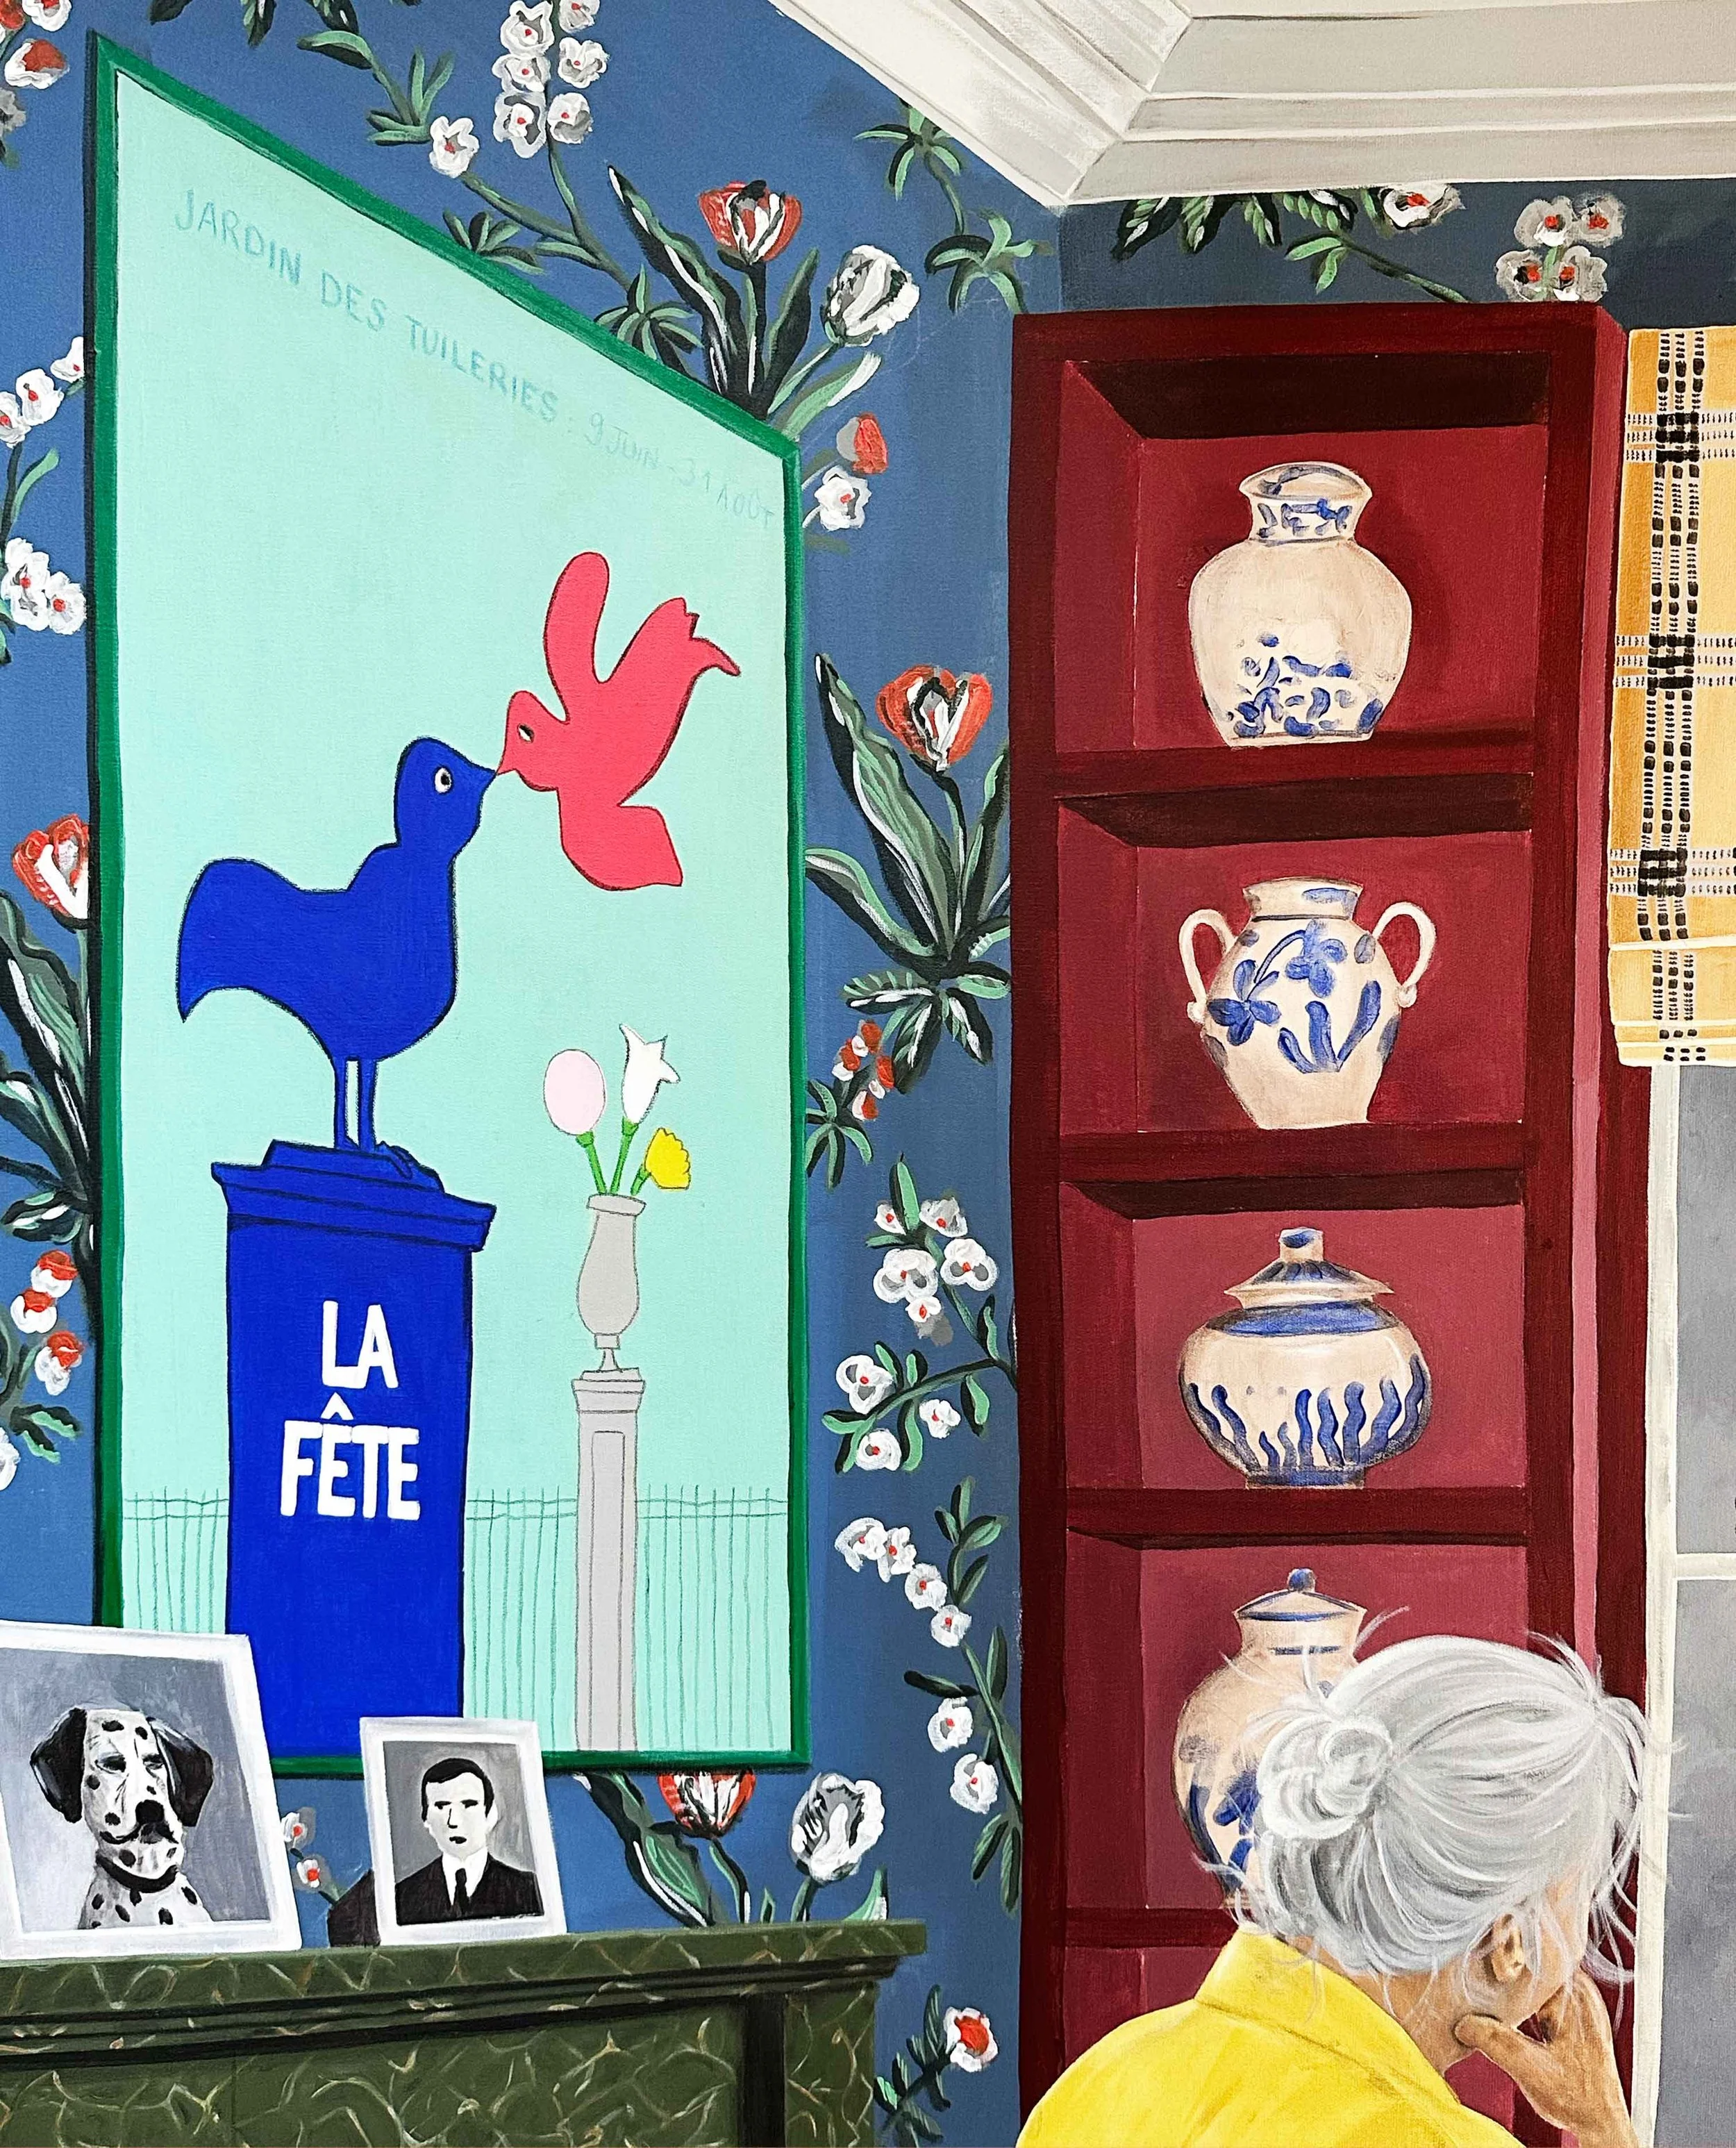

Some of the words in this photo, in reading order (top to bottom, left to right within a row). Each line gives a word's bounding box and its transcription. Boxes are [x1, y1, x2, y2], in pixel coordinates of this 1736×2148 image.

[175, 189, 301, 285] JARDIN
[322, 269, 387, 332] DES
[406, 315, 558, 423] TUILERIES
[583, 413, 603, 446] 9
[322, 1299, 399, 1390] LA
[280, 1391, 421, 1521] FÊTE
